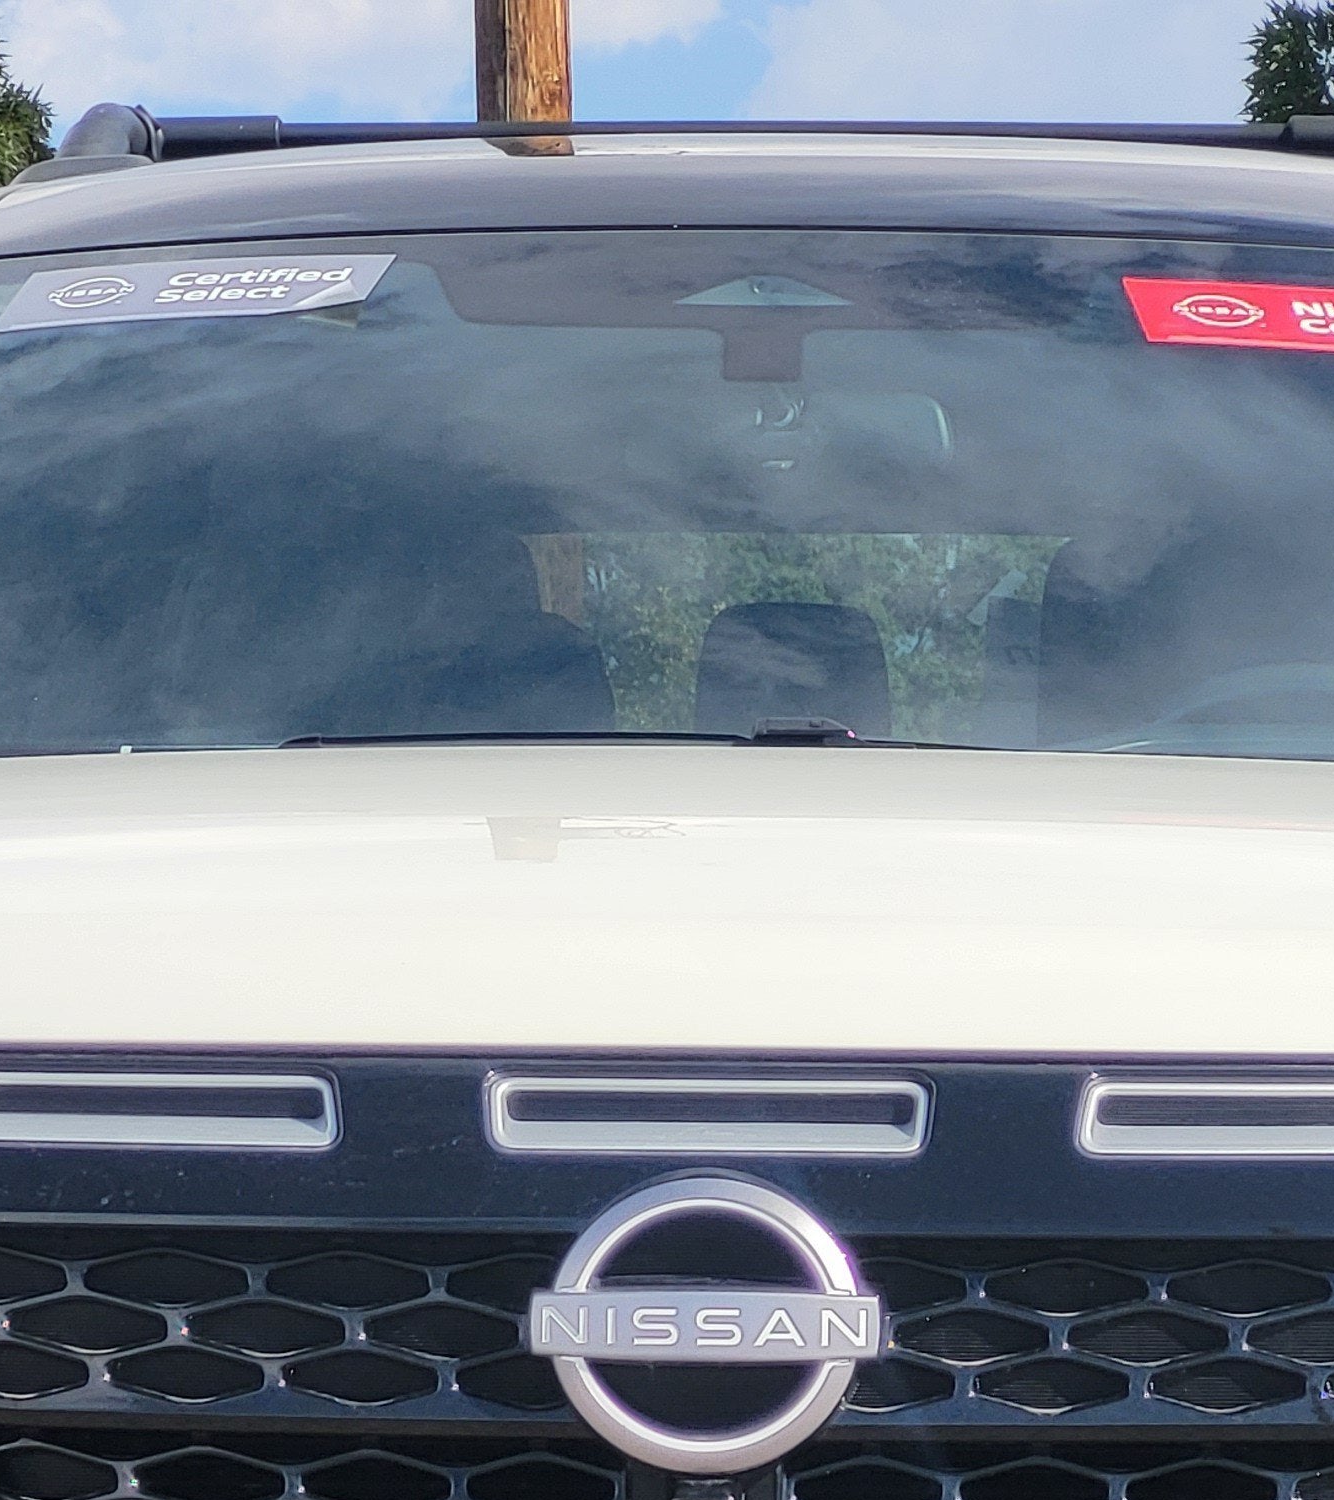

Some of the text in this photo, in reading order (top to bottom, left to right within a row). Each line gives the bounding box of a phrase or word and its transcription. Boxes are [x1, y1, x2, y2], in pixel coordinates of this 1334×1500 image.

[167, 267, 354, 287] Certified
[153, 284, 291, 304] Select
[541, 1304, 868, 1347] NISSAN
